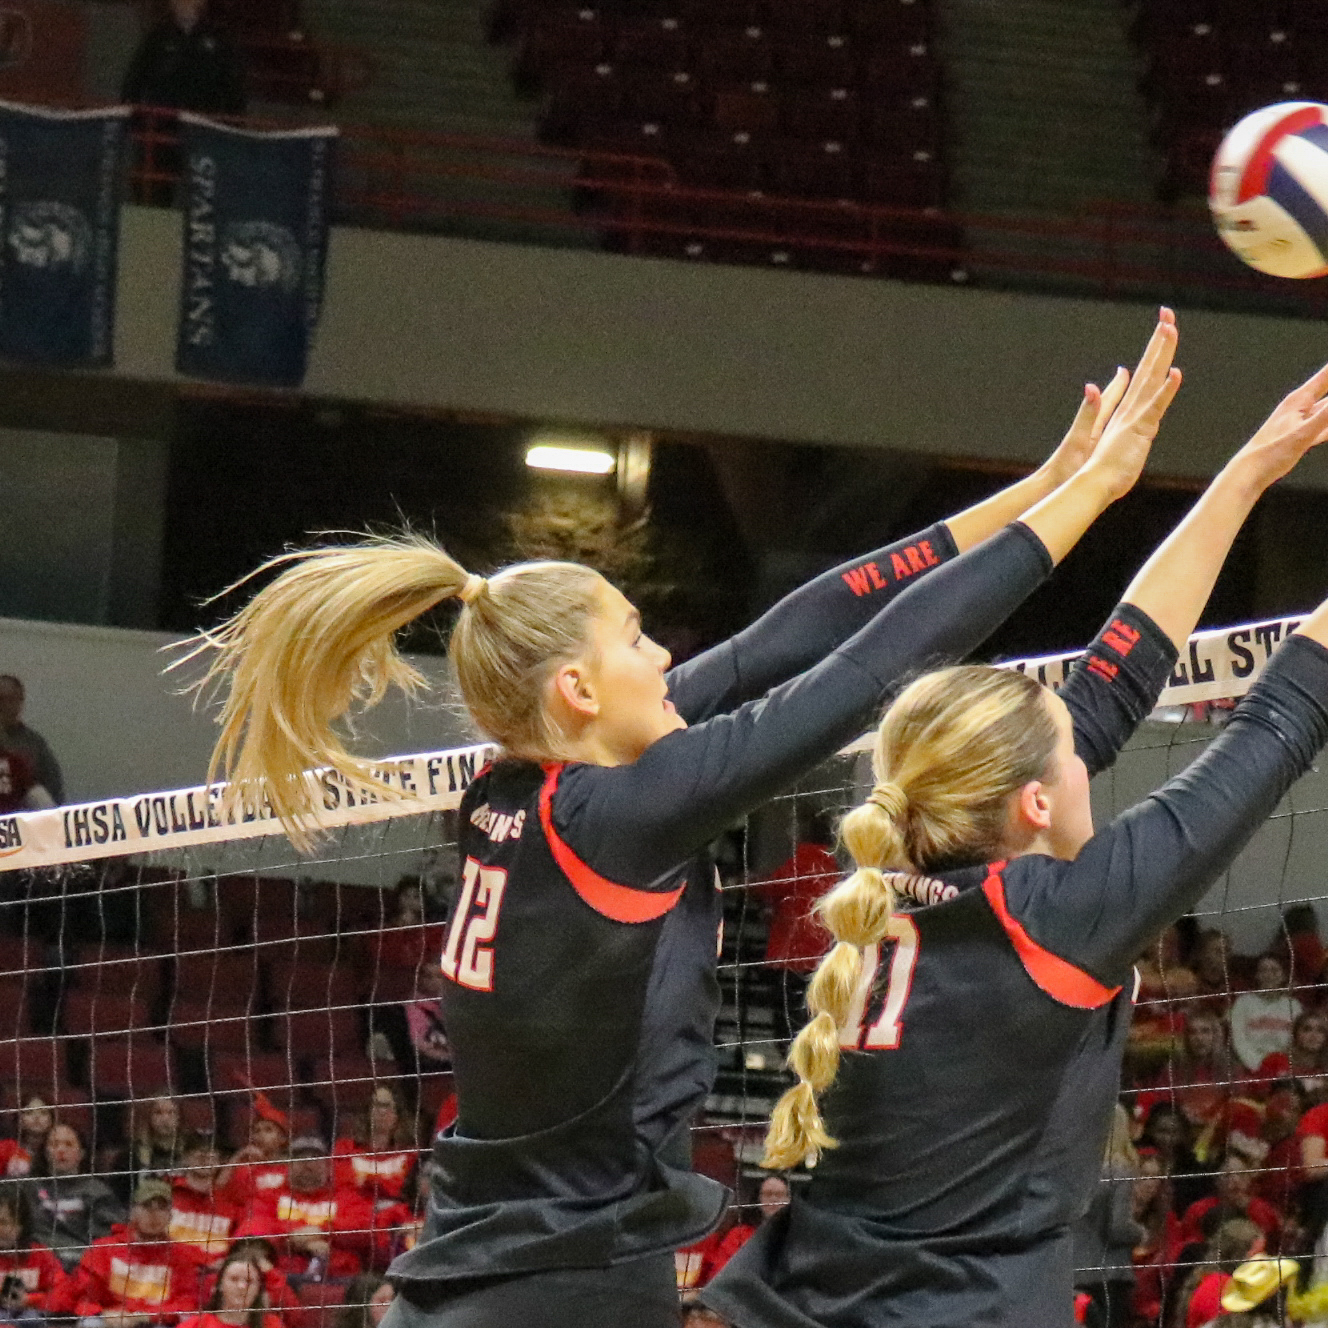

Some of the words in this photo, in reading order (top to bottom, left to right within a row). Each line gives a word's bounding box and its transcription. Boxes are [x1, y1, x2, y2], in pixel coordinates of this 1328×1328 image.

[188, 155, 217, 347] SPARTANS
[841, 562, 889, 597] WE
[890, 540, 941, 581] ARE
[63, 802, 128, 849] IHSA
[426, 749, 478, 797] FIN
[440, 854, 509, 993] 12
